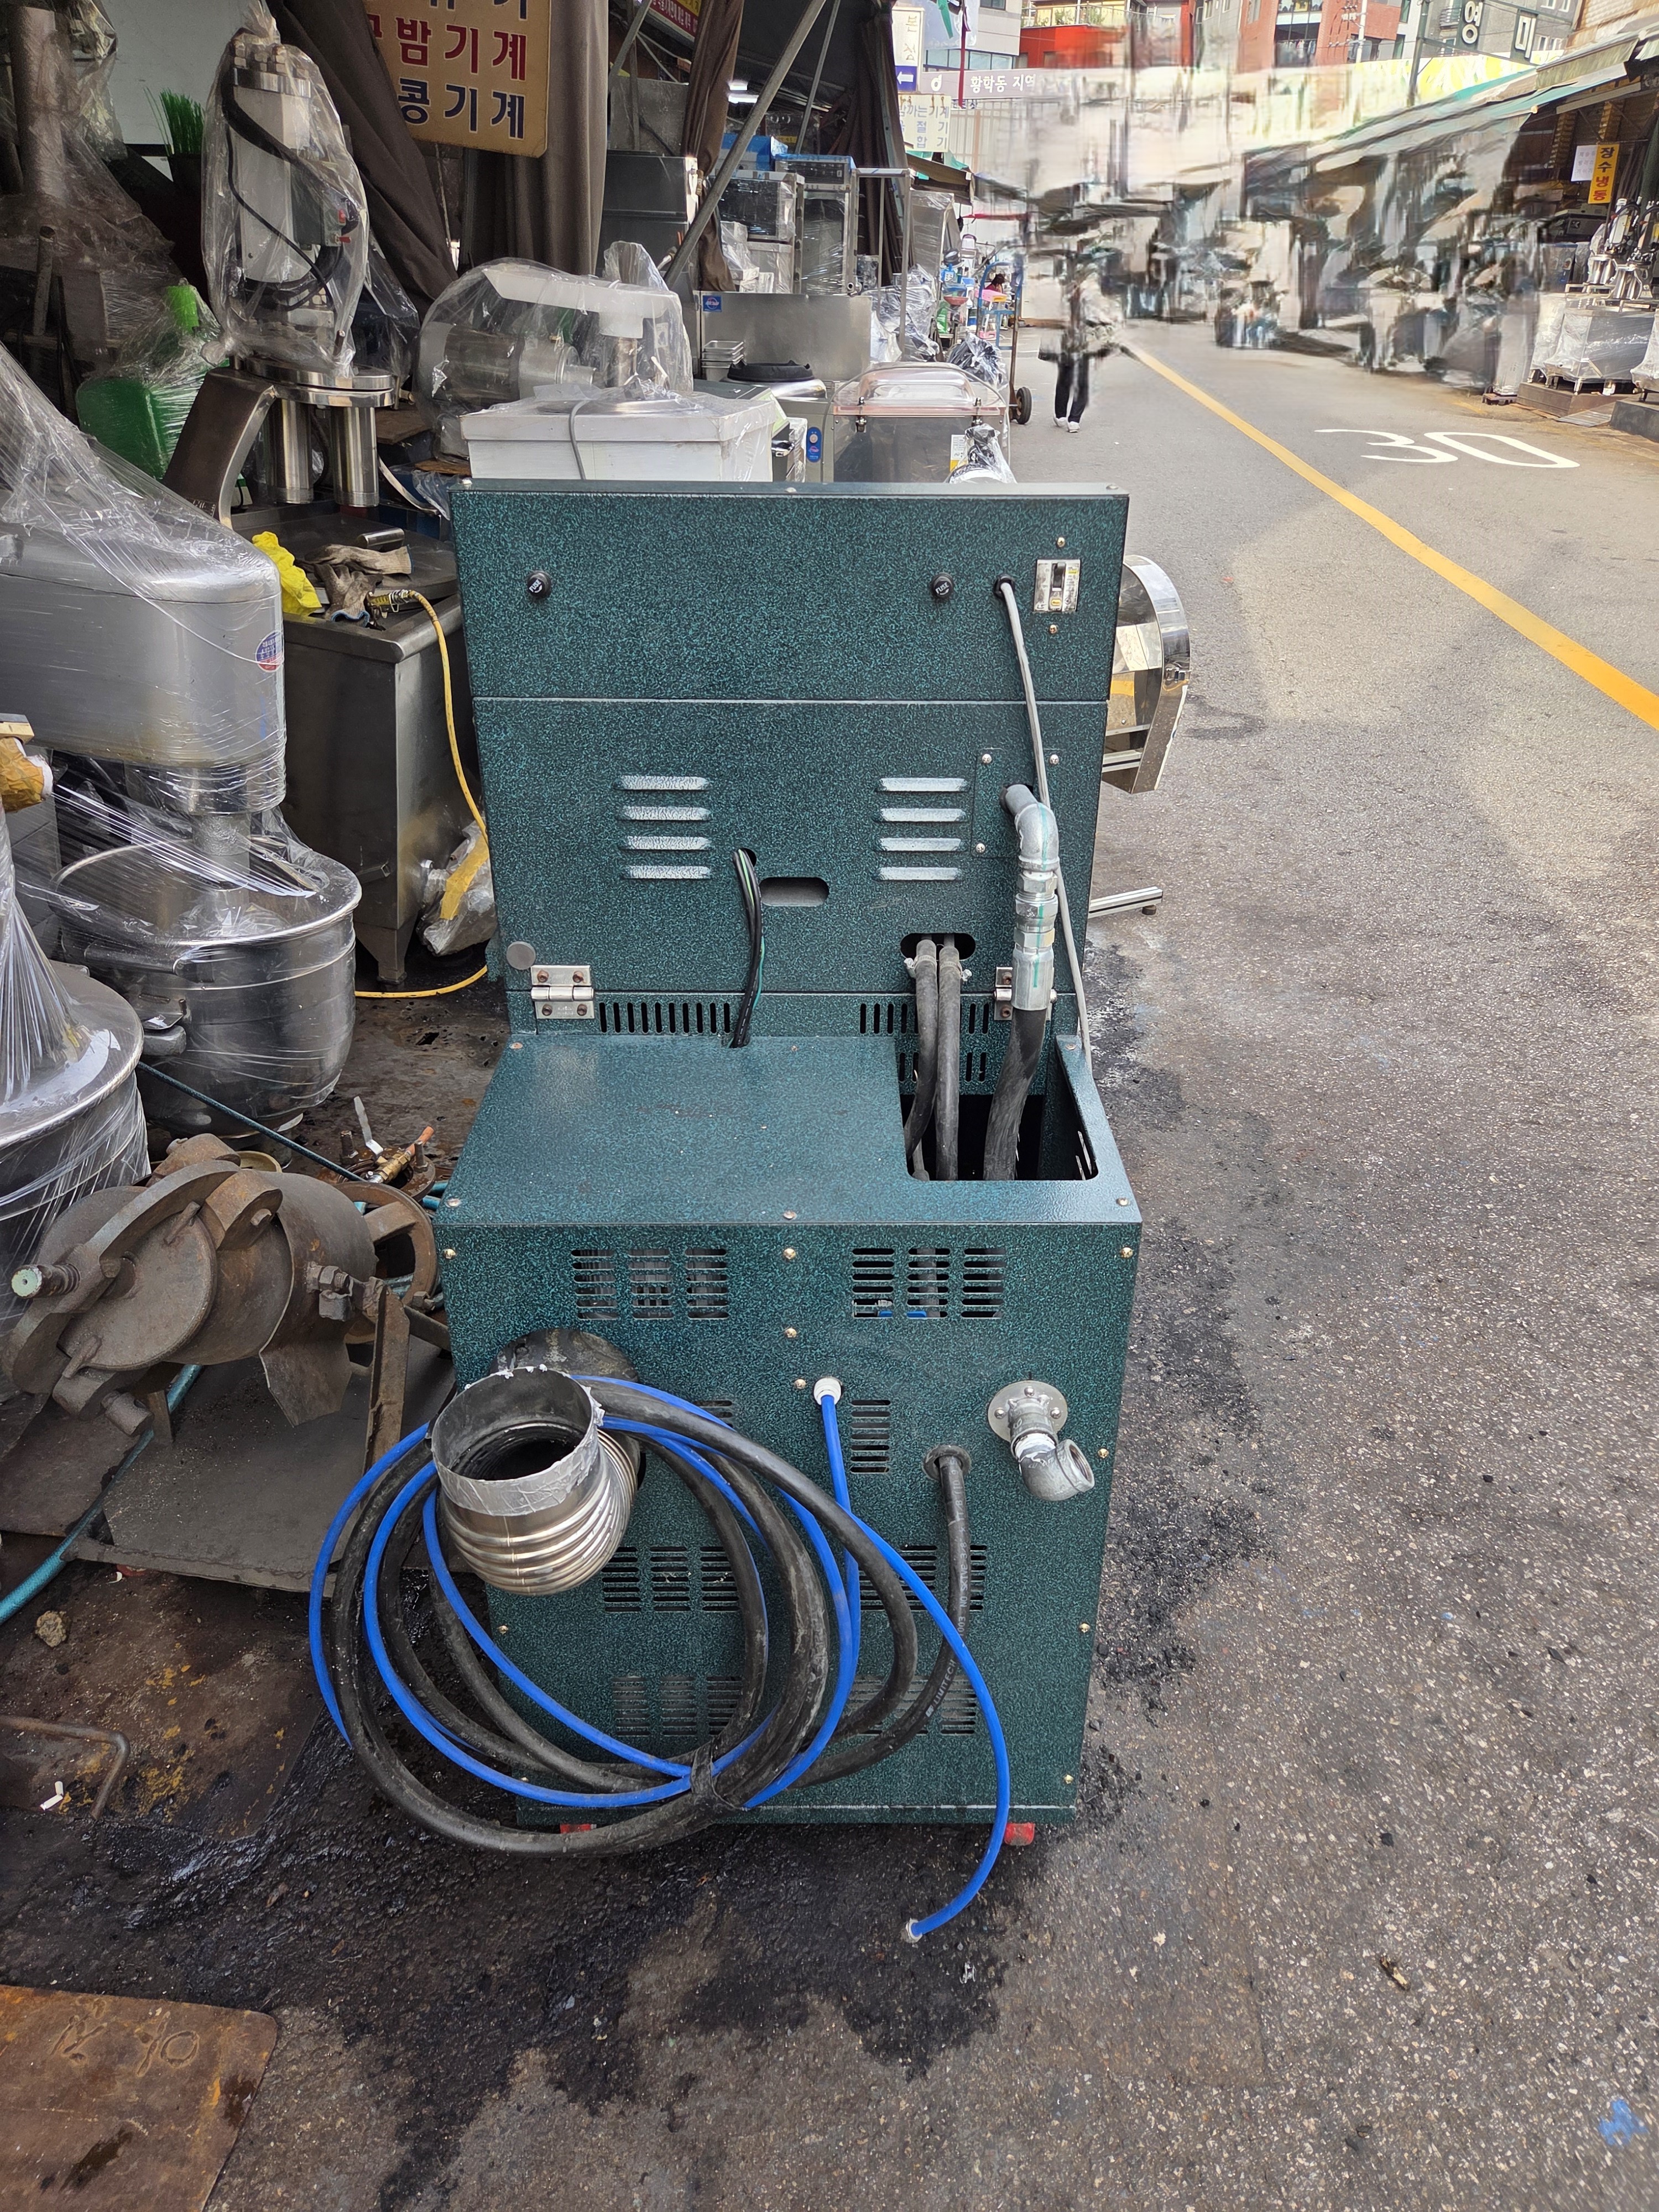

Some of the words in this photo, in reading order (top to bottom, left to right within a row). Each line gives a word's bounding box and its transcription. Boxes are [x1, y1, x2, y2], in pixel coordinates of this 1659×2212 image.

[970, 75, 1008, 94] 황학동
[1593, 147, 1615, 201] 장수냉동
[1314, 428, 1580, 468] 30
[529, 578, 542, 593] FUSE
[935, 582, 950, 594] FUSE
[960, 1596, 968, 1608] NO
